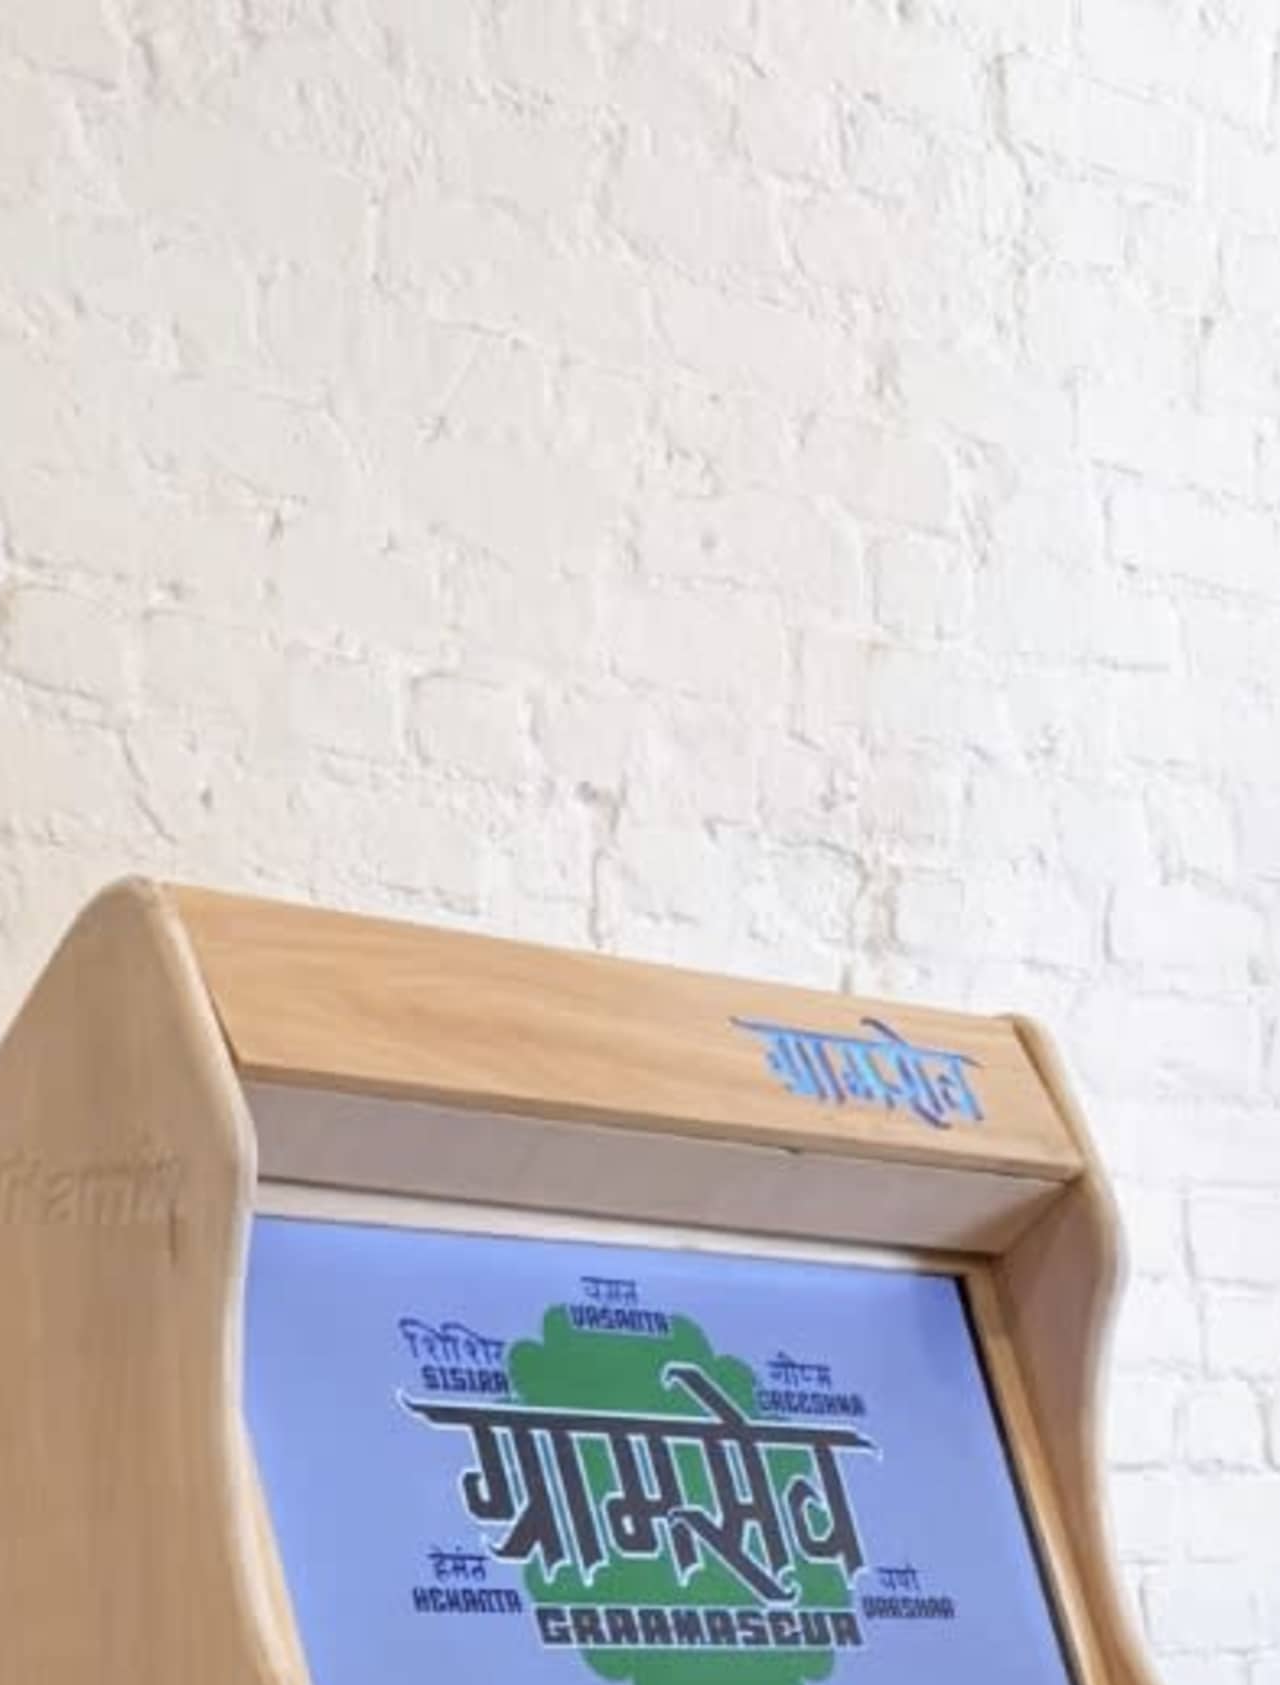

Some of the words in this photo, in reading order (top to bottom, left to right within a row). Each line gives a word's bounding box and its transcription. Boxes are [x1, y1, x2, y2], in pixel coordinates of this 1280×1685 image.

[569, 1304, 669, 1335] VASANTA
[421, 1364, 510, 1394] SISIRA
[398, 1363, 882, 1605] ग्रामसेव
[412, 1586, 524, 1614] HEMANTA
[534, 1606, 864, 1647] GRAAMASEVA
